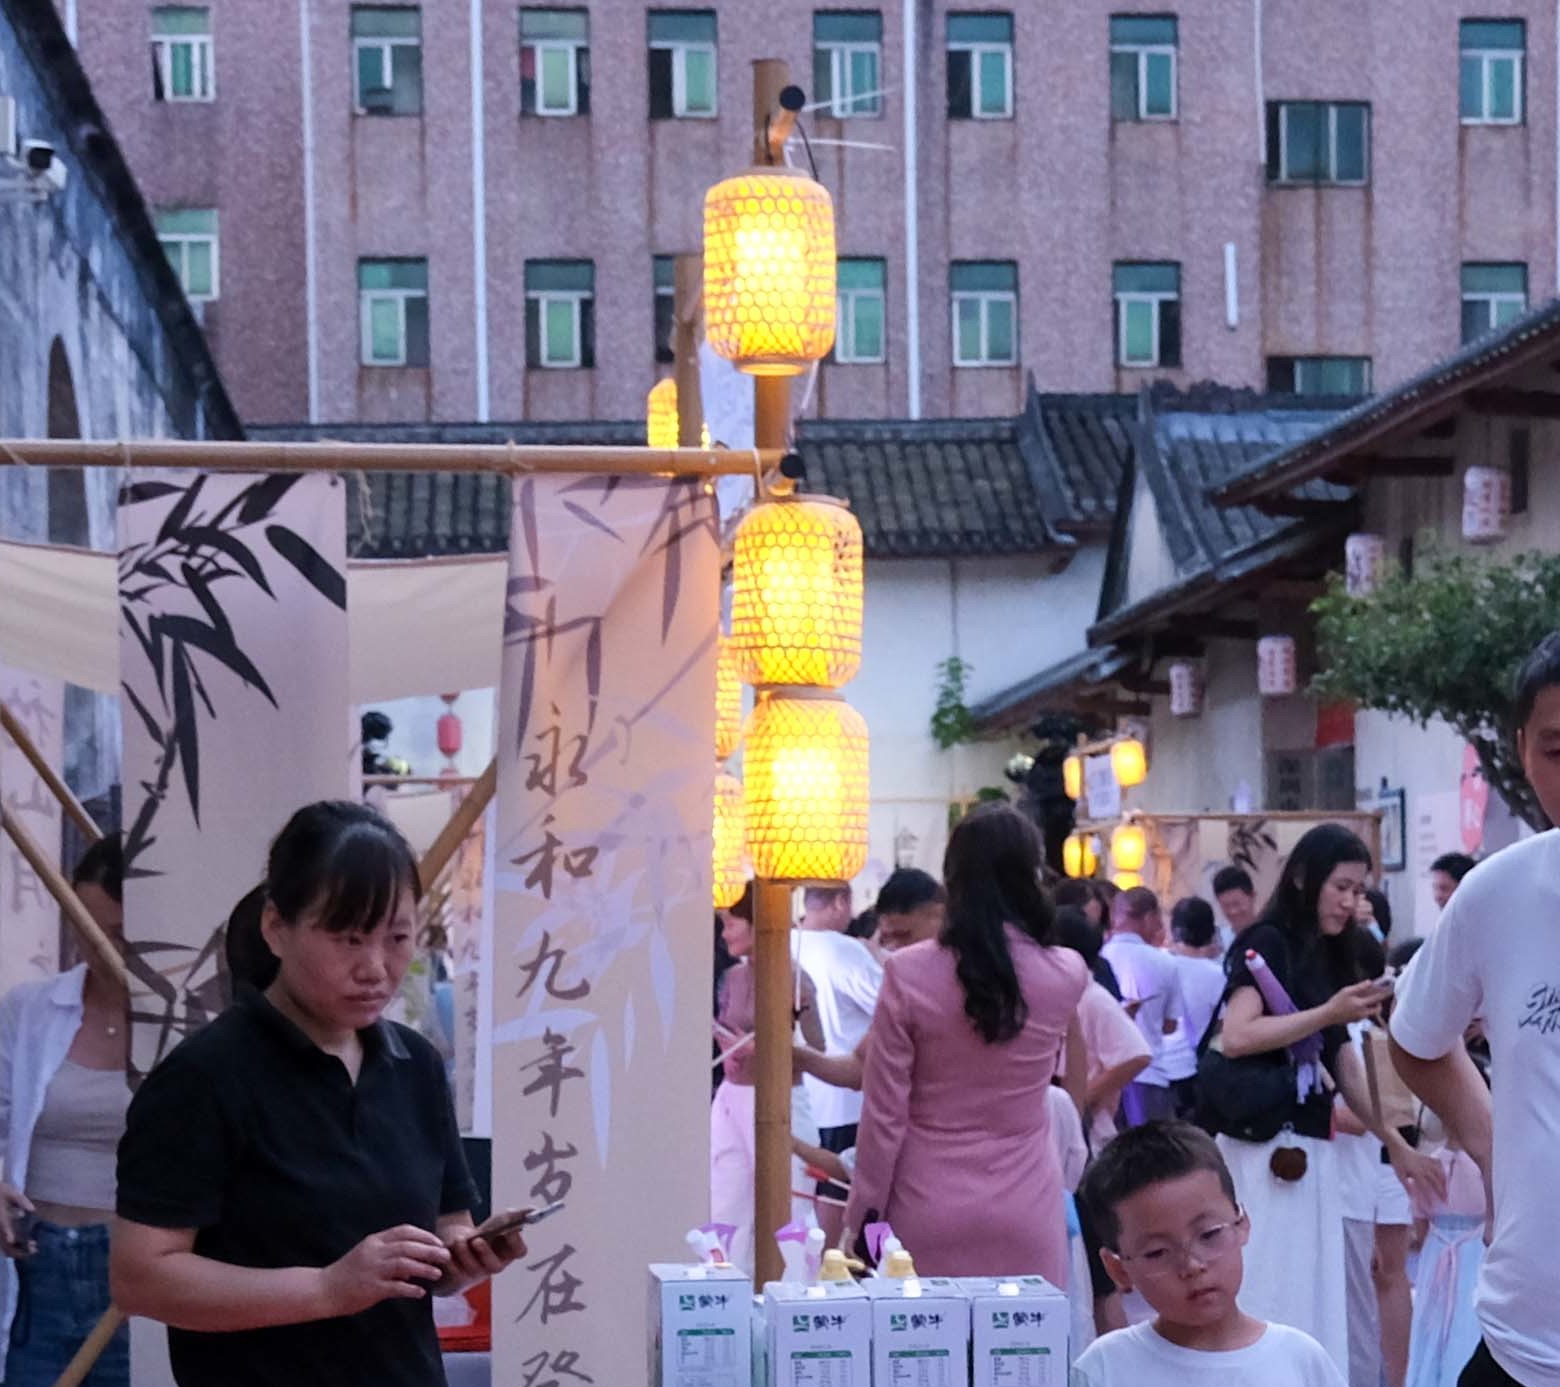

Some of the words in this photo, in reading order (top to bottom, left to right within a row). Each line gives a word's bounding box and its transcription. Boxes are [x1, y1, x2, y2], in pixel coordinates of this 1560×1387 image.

[697, 1293, 730, 1311] 蒙牛
[813, 1313, 847, 1331] 蒙牛
[910, 1312, 944, 1330] 蒙牛
[1012, 1311, 1046, 1329] 蒙牛
